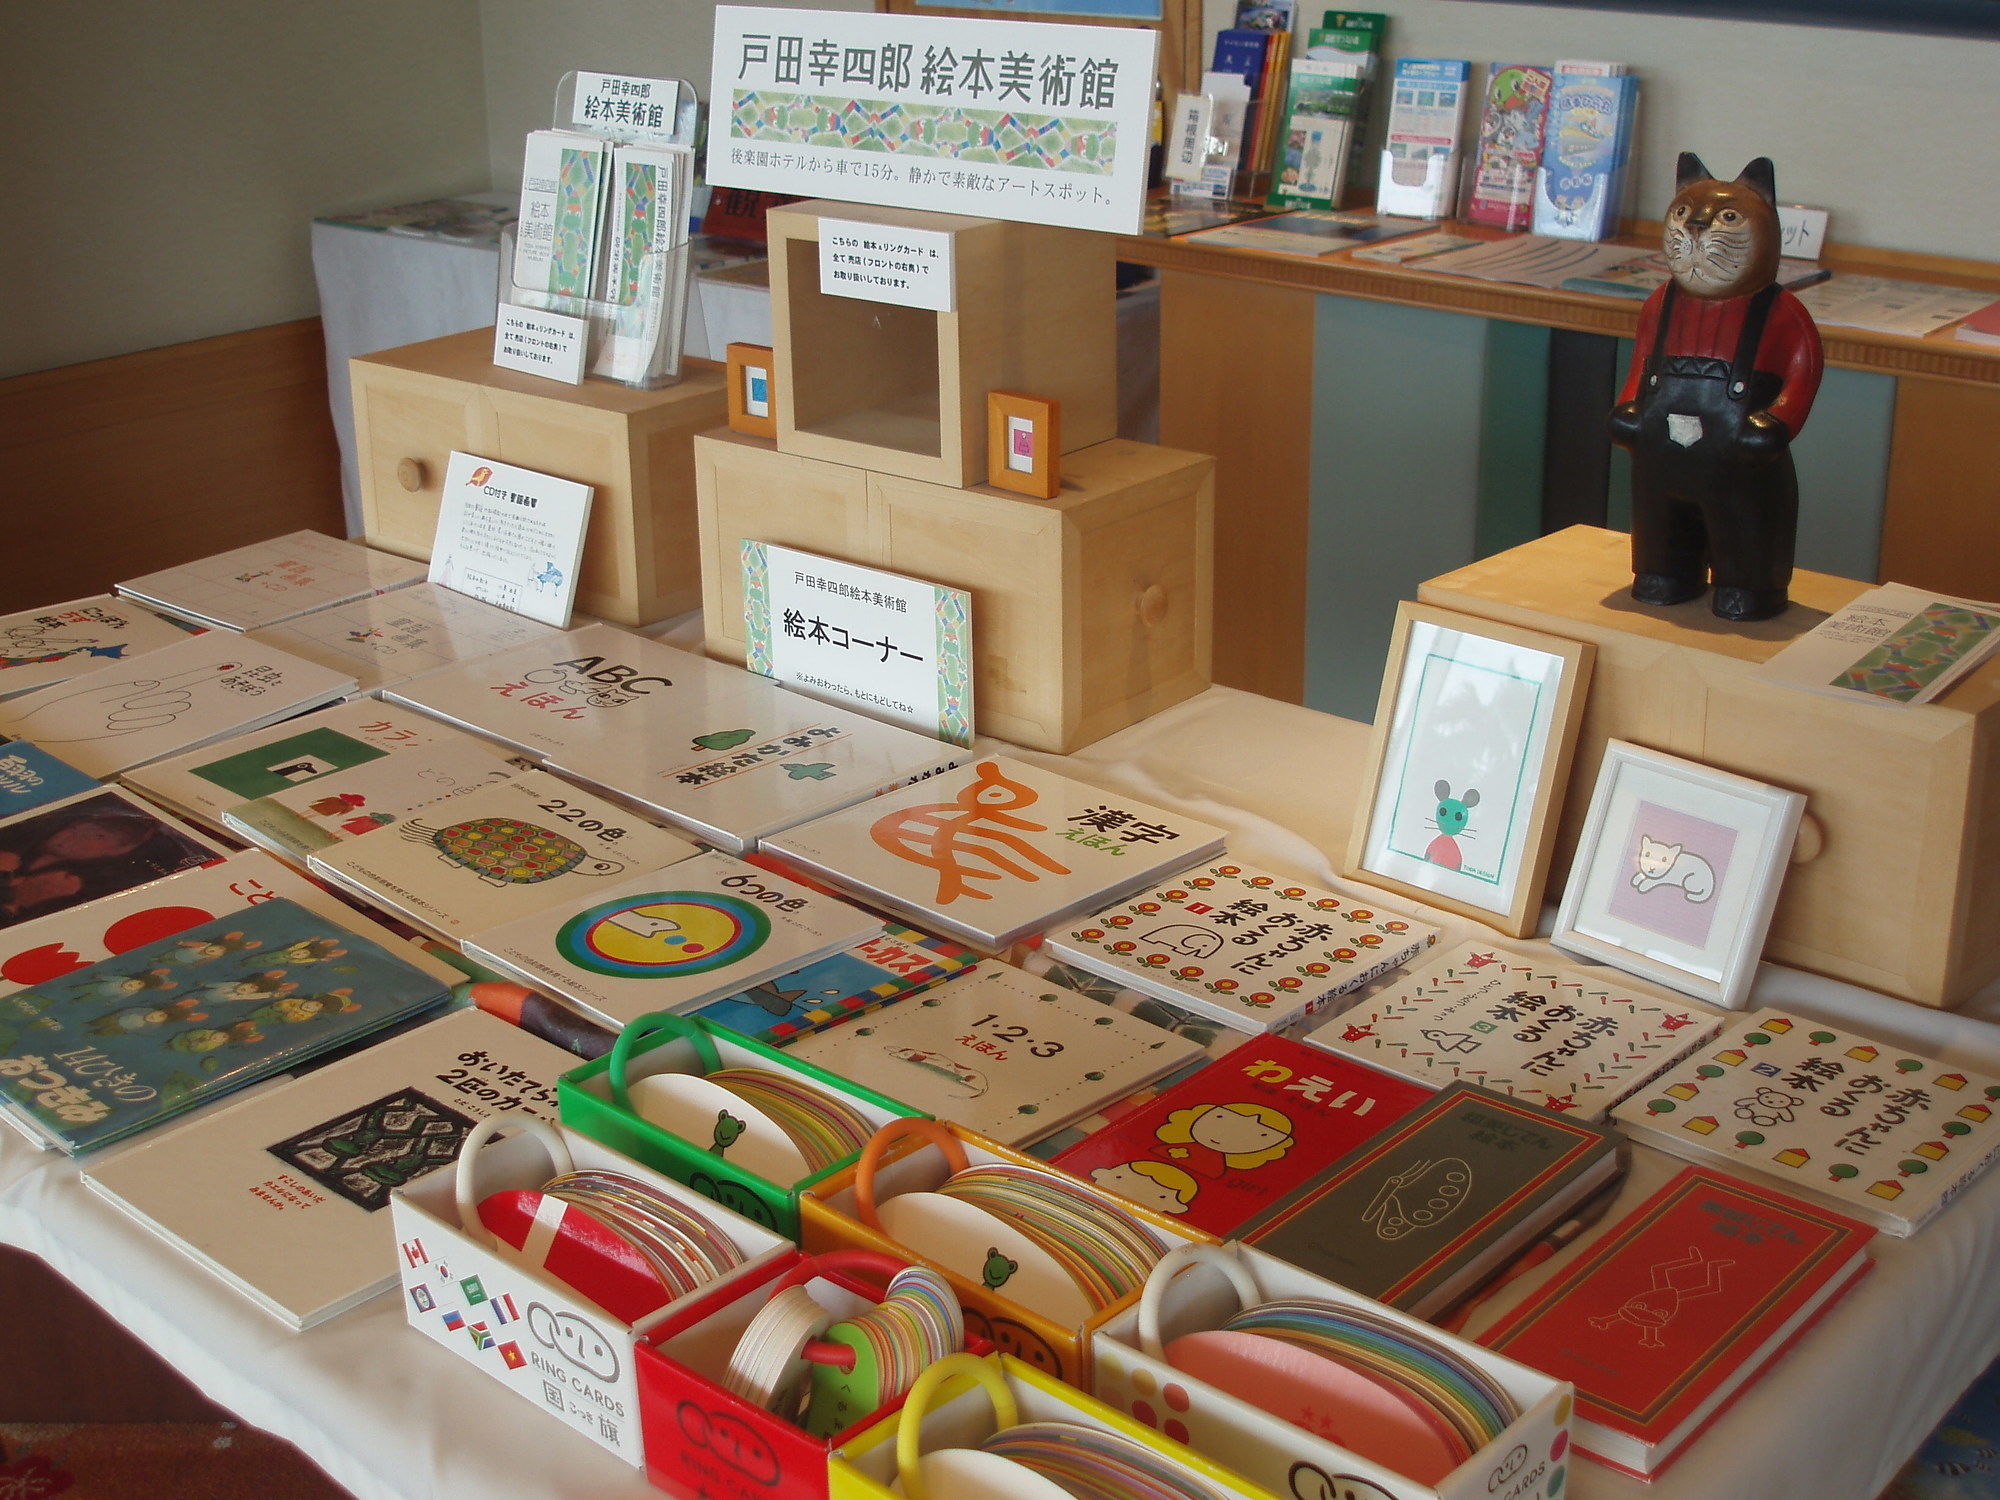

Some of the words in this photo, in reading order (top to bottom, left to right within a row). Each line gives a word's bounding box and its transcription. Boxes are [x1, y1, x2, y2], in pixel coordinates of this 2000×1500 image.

[601, 78, 651, 98] 戸田幸四郎
[738, 34, 913, 92] 戸田幸四郎
[920, 45, 1119, 109] 絵本美術館
[584, 95, 663, 128] 絵本美術館
[832, 237, 859, 247] こちらの
[794, 570, 907, 613] 戸田幸四郎絵本美術館
[783, 608, 923, 662] 絵本コーナー
[553, 656, 673, 694] ABC
[490, 681, 587, 720] えほん
[538, 799, 627, 842] 22の色
[1067, 805, 1180, 844] 漢字
[1055, 826, 1128, 856] えほん
[721, 875, 808, 912] 6つの色
[1210, 898, 1267, 926] 絵本
[1231, 911, 1302, 945] おくる
[1231, 922, 1334, 976] 赤ちゃんに
[1485, 991, 1548, 1022] 絵本
[1513, 1005, 1584, 1043] おくる
[955, 1034, 1008, 1060] えほん
[1520, 1016, 1619, 1076] 赤ちゃんに
[54, 1046, 157, 1101] 14ひきの
[1241, 1060, 1376, 1116] わえい
[1782, 1056, 1845, 1092] 絵本
[1820, 1074, 1891, 1116] おくる
[1834, 1088, 1931, 1155] 赤ちゃんに
[531, 1350, 568, 1384] RING
[571, 1377, 626, 1418] CARDS
